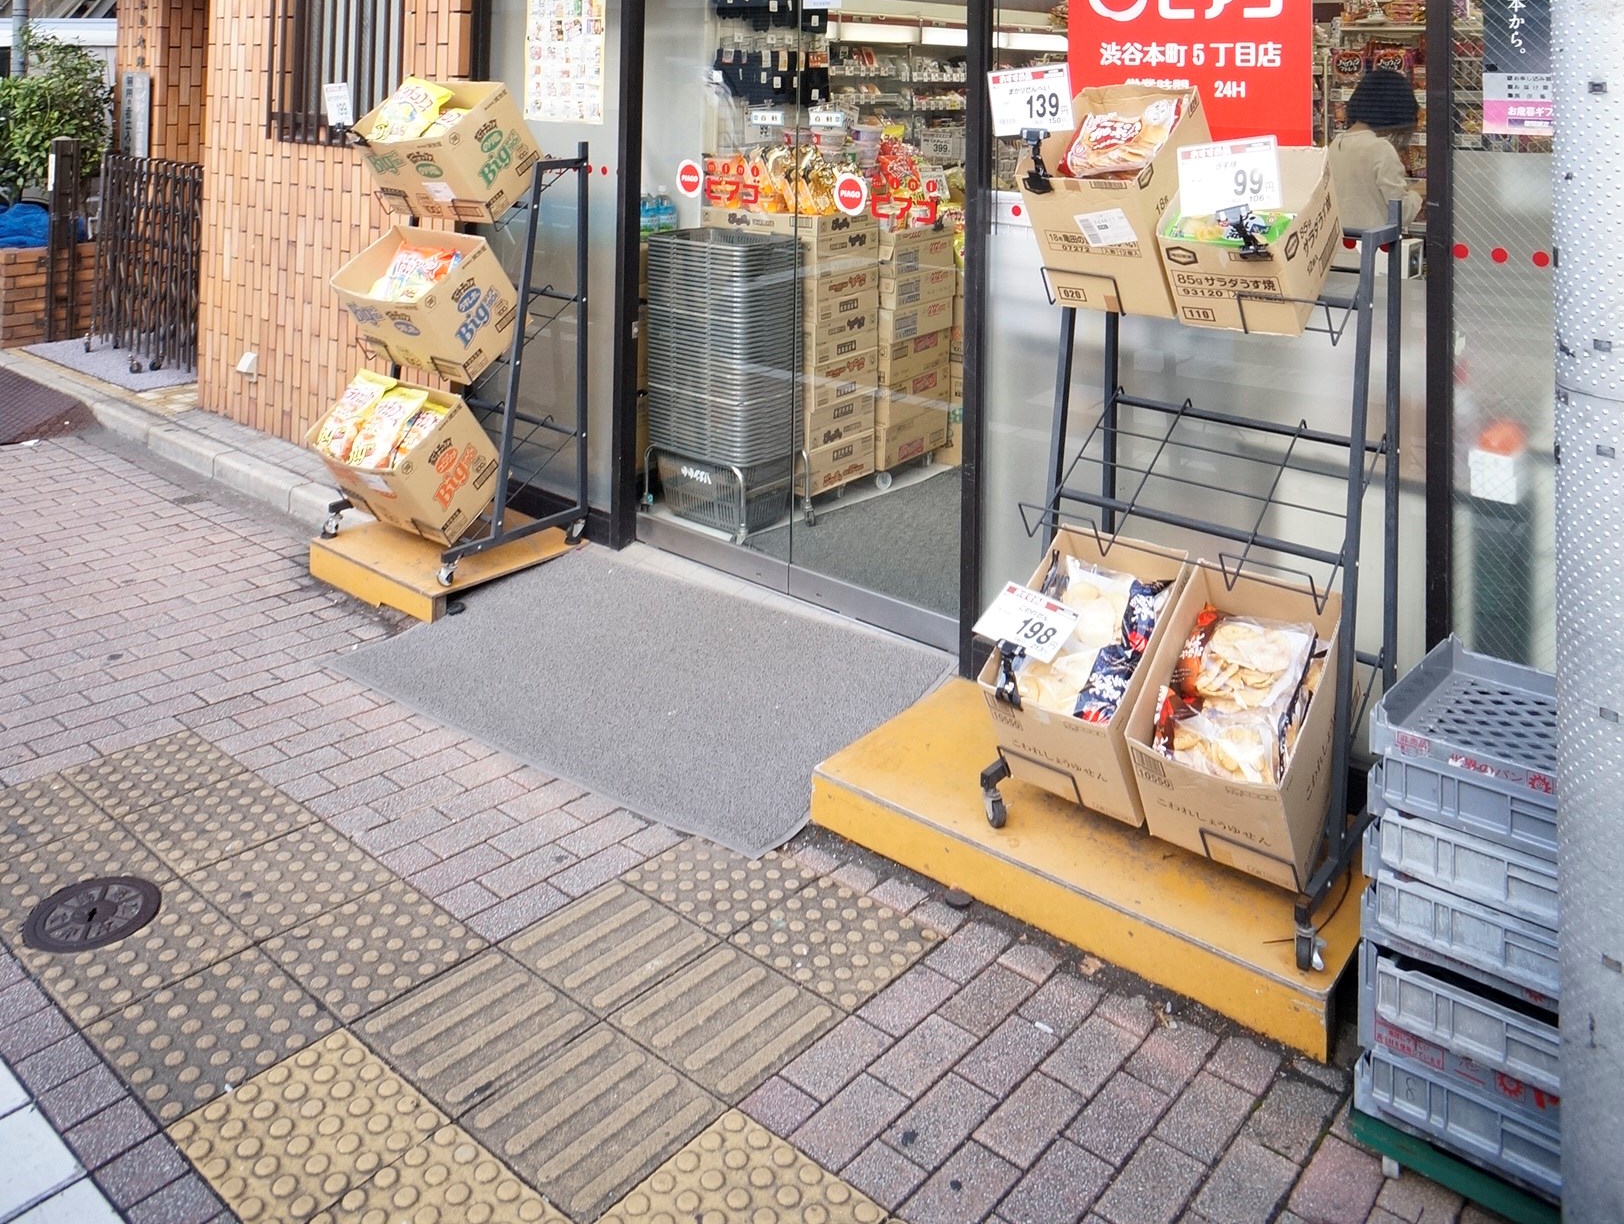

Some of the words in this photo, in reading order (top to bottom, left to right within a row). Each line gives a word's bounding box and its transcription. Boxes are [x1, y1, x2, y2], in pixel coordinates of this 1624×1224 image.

[1214, 80, 1246, 98] 24H
[933, 143, 948, 152] 399
[478, 146, 511, 190] Big
[681, 174, 698, 182] PIAGO
[706, 176, 760, 204] ピアゴ
[840, 189, 861, 199] PIAGO
[871, 192, 938, 224] ピアゴ
[1061, 244, 1091, 253] 07272
[1063, 289, 1082, 299] 020
[1182, 288, 1223, 297] 93120
[1187, 309, 1210, 319] 110
[455, 303, 490, 350] Big
[433, 462, 469, 512] Big
[1012, 739, 1109, 783] こわれしょうゆせん
[1156, 797, 1272, 847] こわれしょうゆせん
